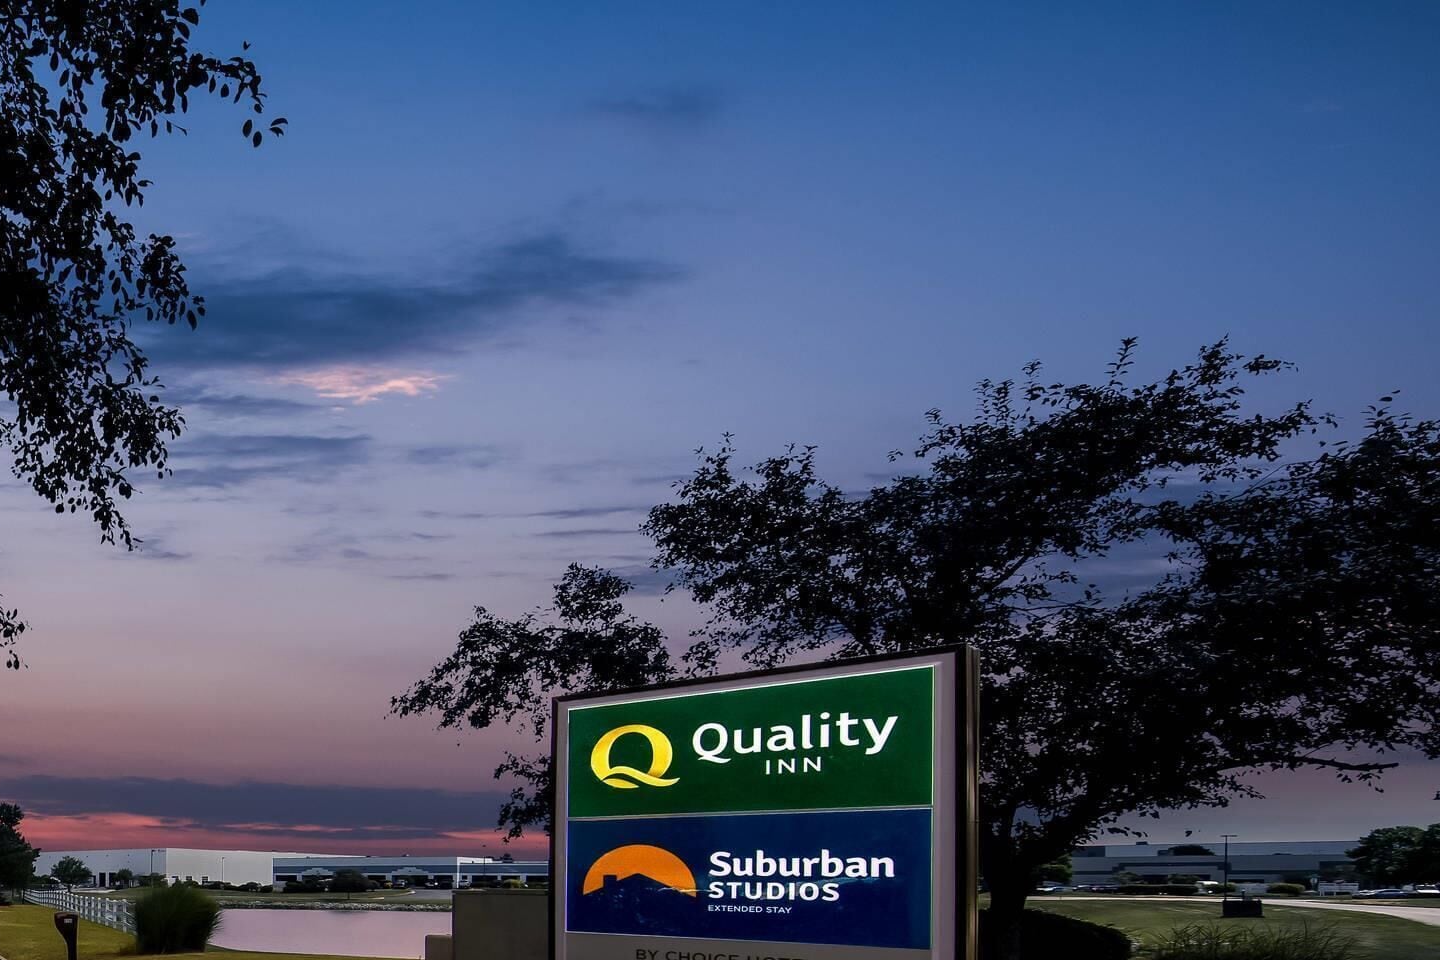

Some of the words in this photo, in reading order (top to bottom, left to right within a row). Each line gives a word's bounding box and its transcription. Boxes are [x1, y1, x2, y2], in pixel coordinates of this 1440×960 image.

[590, 724, 680, 789] Q
[692, 711, 899, 764] Quality
[765, 756, 822, 775] INN
[708, 848, 895, 878] Suburban
[708, 881, 840, 902] STUDIOS
[708, 904, 763, 914] EXTENDED
[766, 906, 792, 914] STAY
[635, 948, 659, 960] BY
